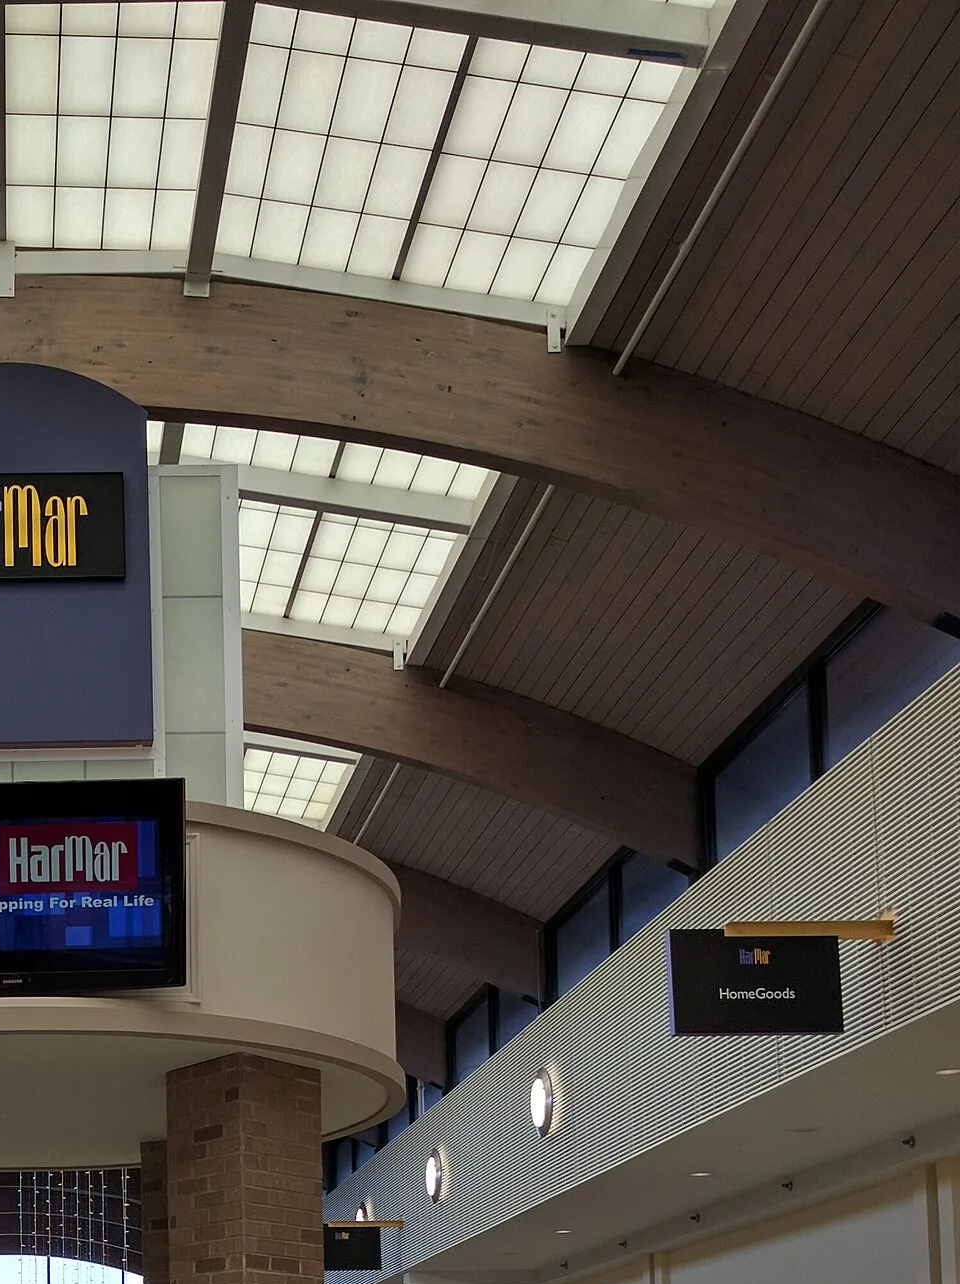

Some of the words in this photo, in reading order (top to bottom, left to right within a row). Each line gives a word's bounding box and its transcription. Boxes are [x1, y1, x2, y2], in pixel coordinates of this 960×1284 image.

[8, 835, 128, 883] HarMar
[49, 896, 76, 909] For
[81, 895, 117, 908] Real
[124, 894, 155, 907] Life
[719, 986, 796, 999] HomeGoods
